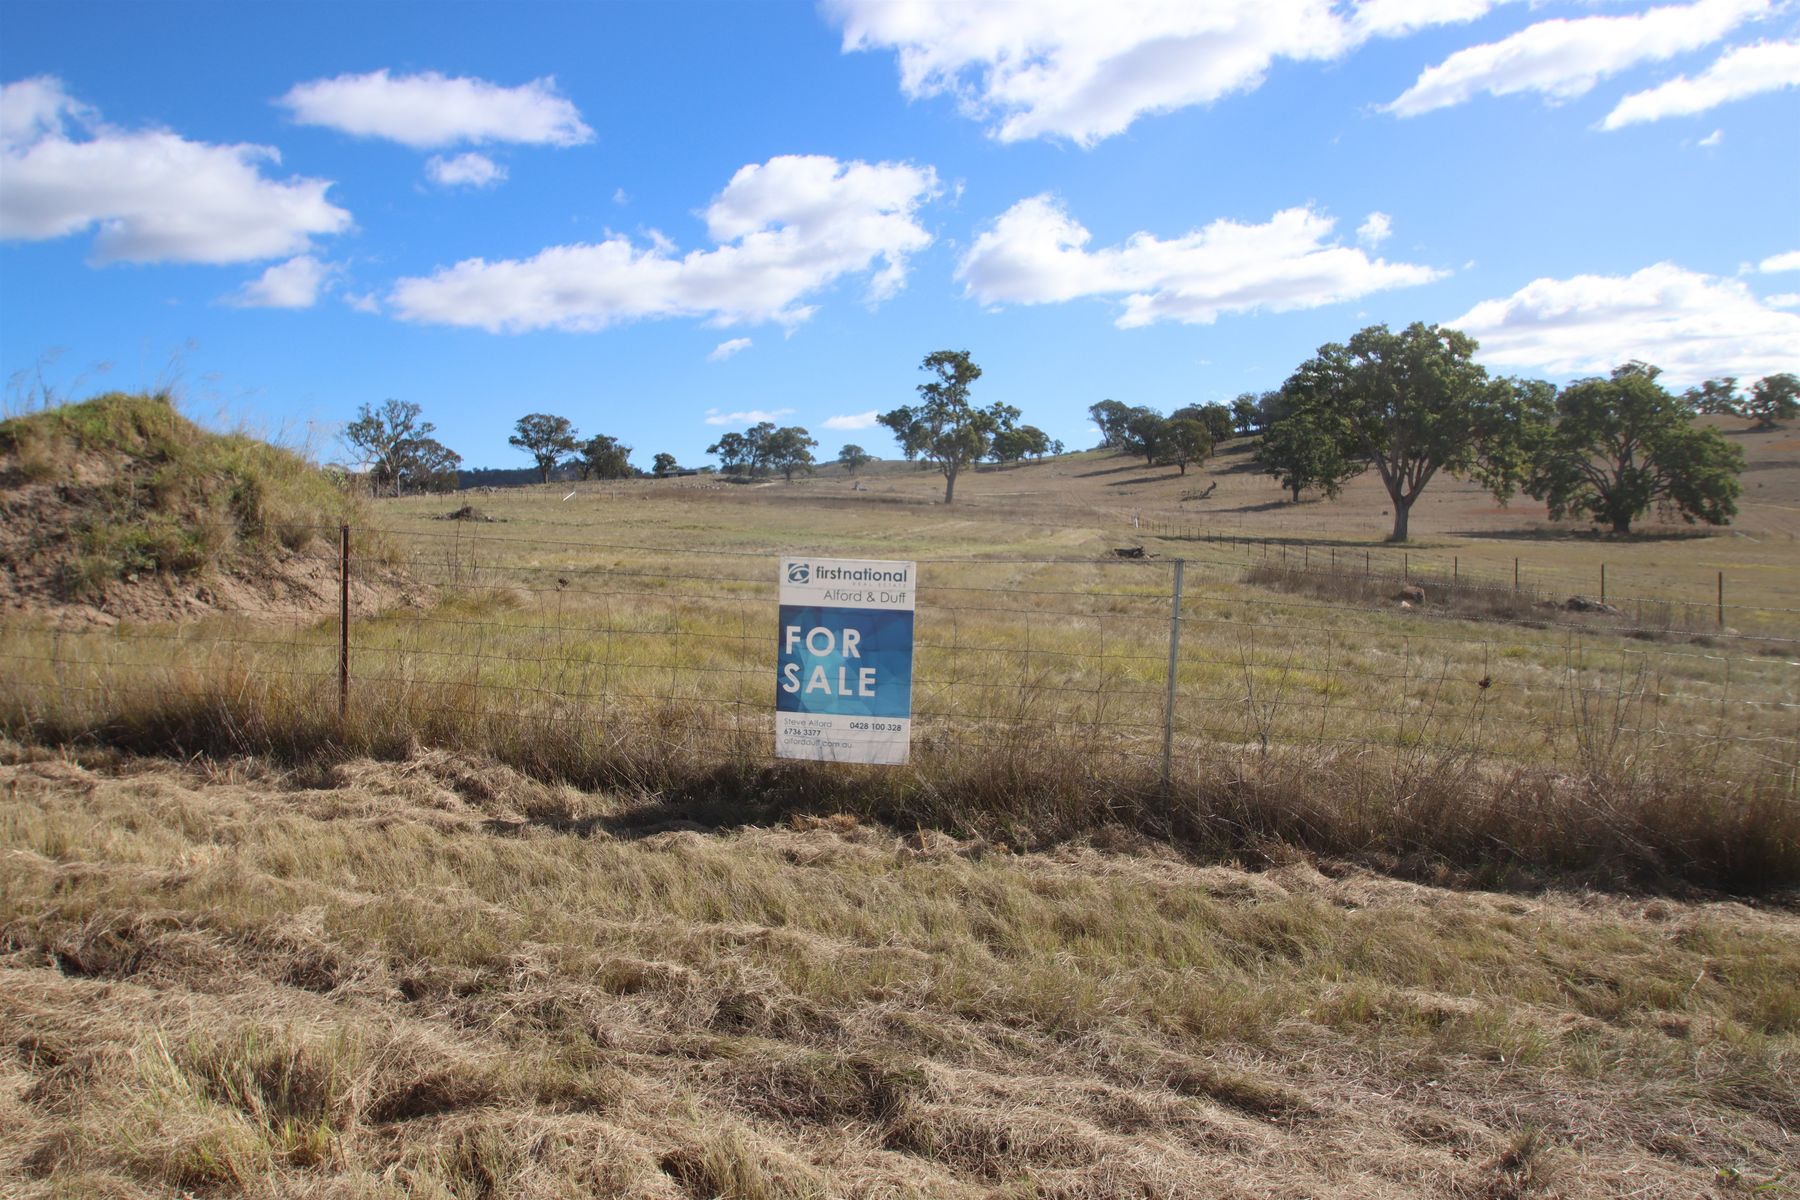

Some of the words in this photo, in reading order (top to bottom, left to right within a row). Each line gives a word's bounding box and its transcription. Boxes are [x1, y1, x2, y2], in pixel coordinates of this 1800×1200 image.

[816, 566, 907, 582] firstnational
[823, 590, 862, 602] Alford
[866, 591, 875, 603] &
[880, 592, 906, 604] Duff
[786, 625, 861, 658] FOR
[782, 663, 876, 697] SALE
[783, 717, 806, 726] Steve
[808, 719, 832, 728] Alford
[849, 722, 868, 730] 0428
[872, 723, 885, 731] 100
[887, 723, 902, 732] 328
[783, 728, 801, 736] 6736
[803, 729, 821, 737] 3377
